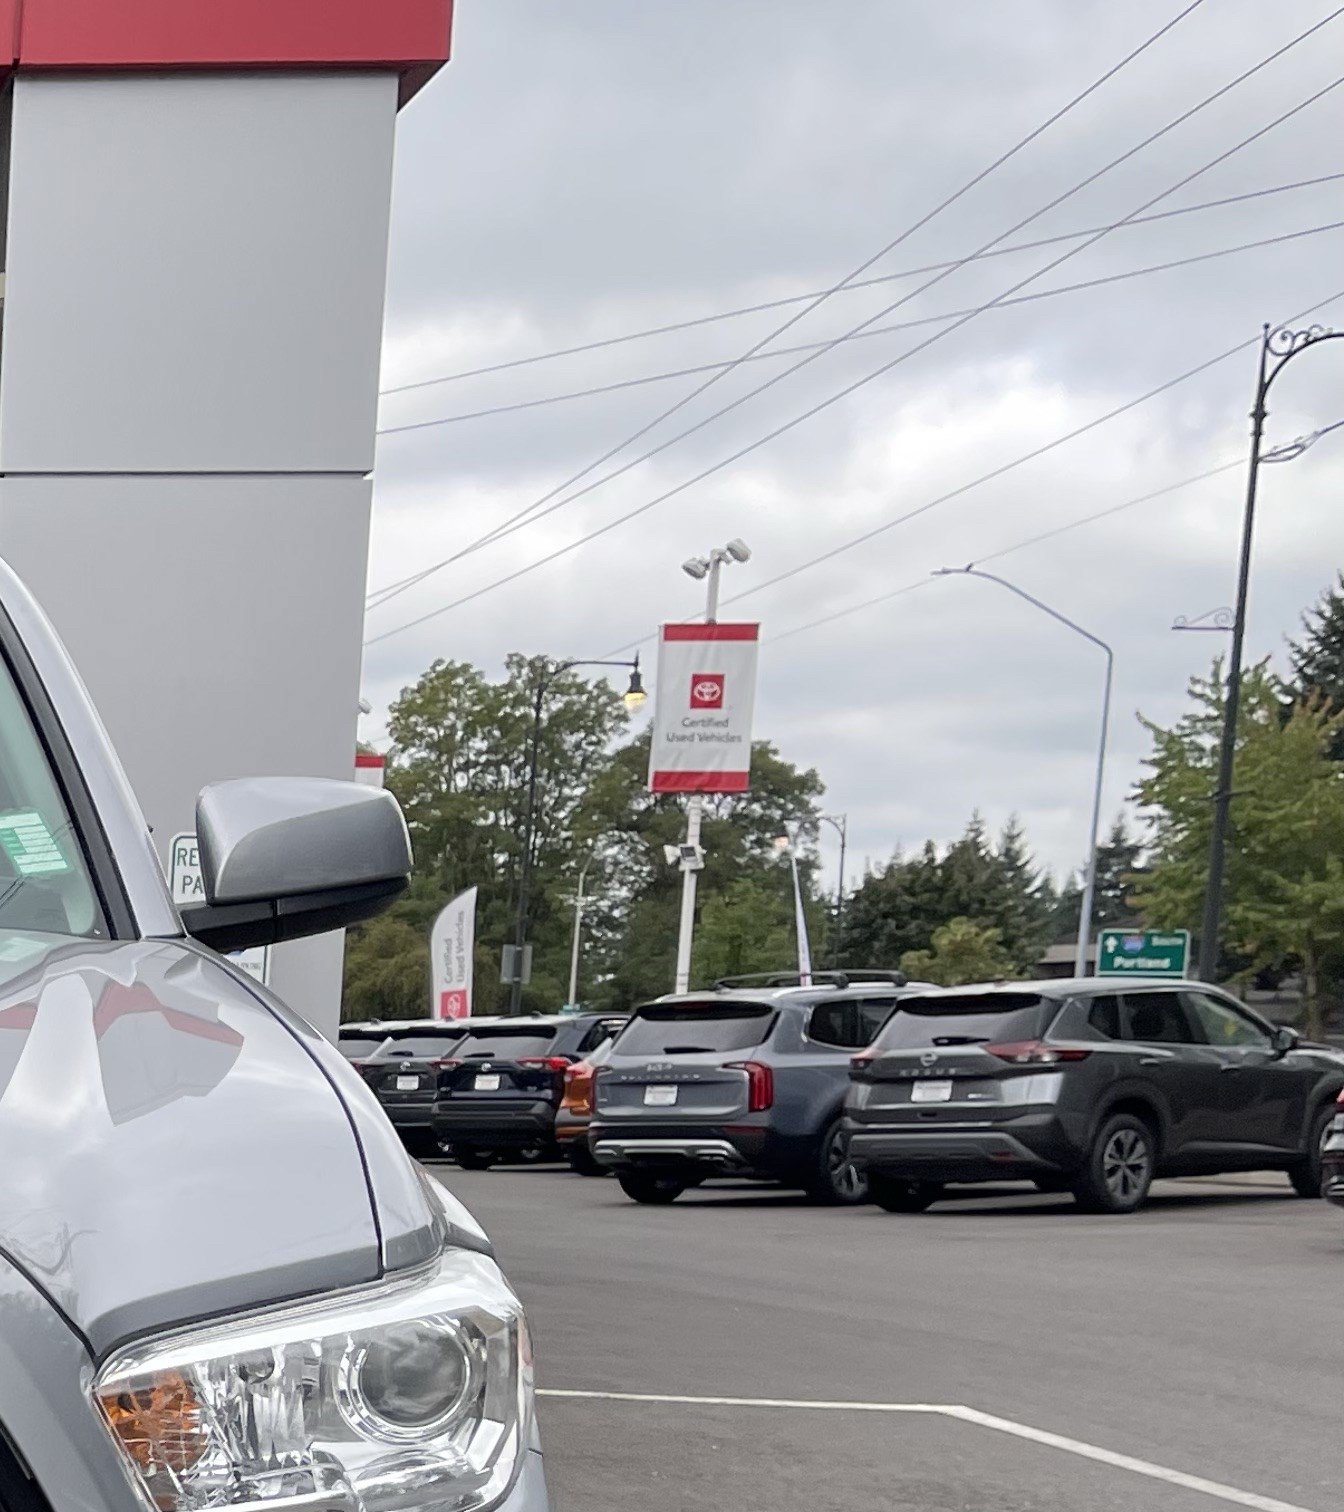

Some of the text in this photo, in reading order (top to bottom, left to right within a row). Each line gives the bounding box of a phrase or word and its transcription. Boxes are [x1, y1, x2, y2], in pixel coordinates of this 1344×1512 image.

[680, 716, 730, 728] Certified
[666, 731, 743, 743] Used Vehicles
